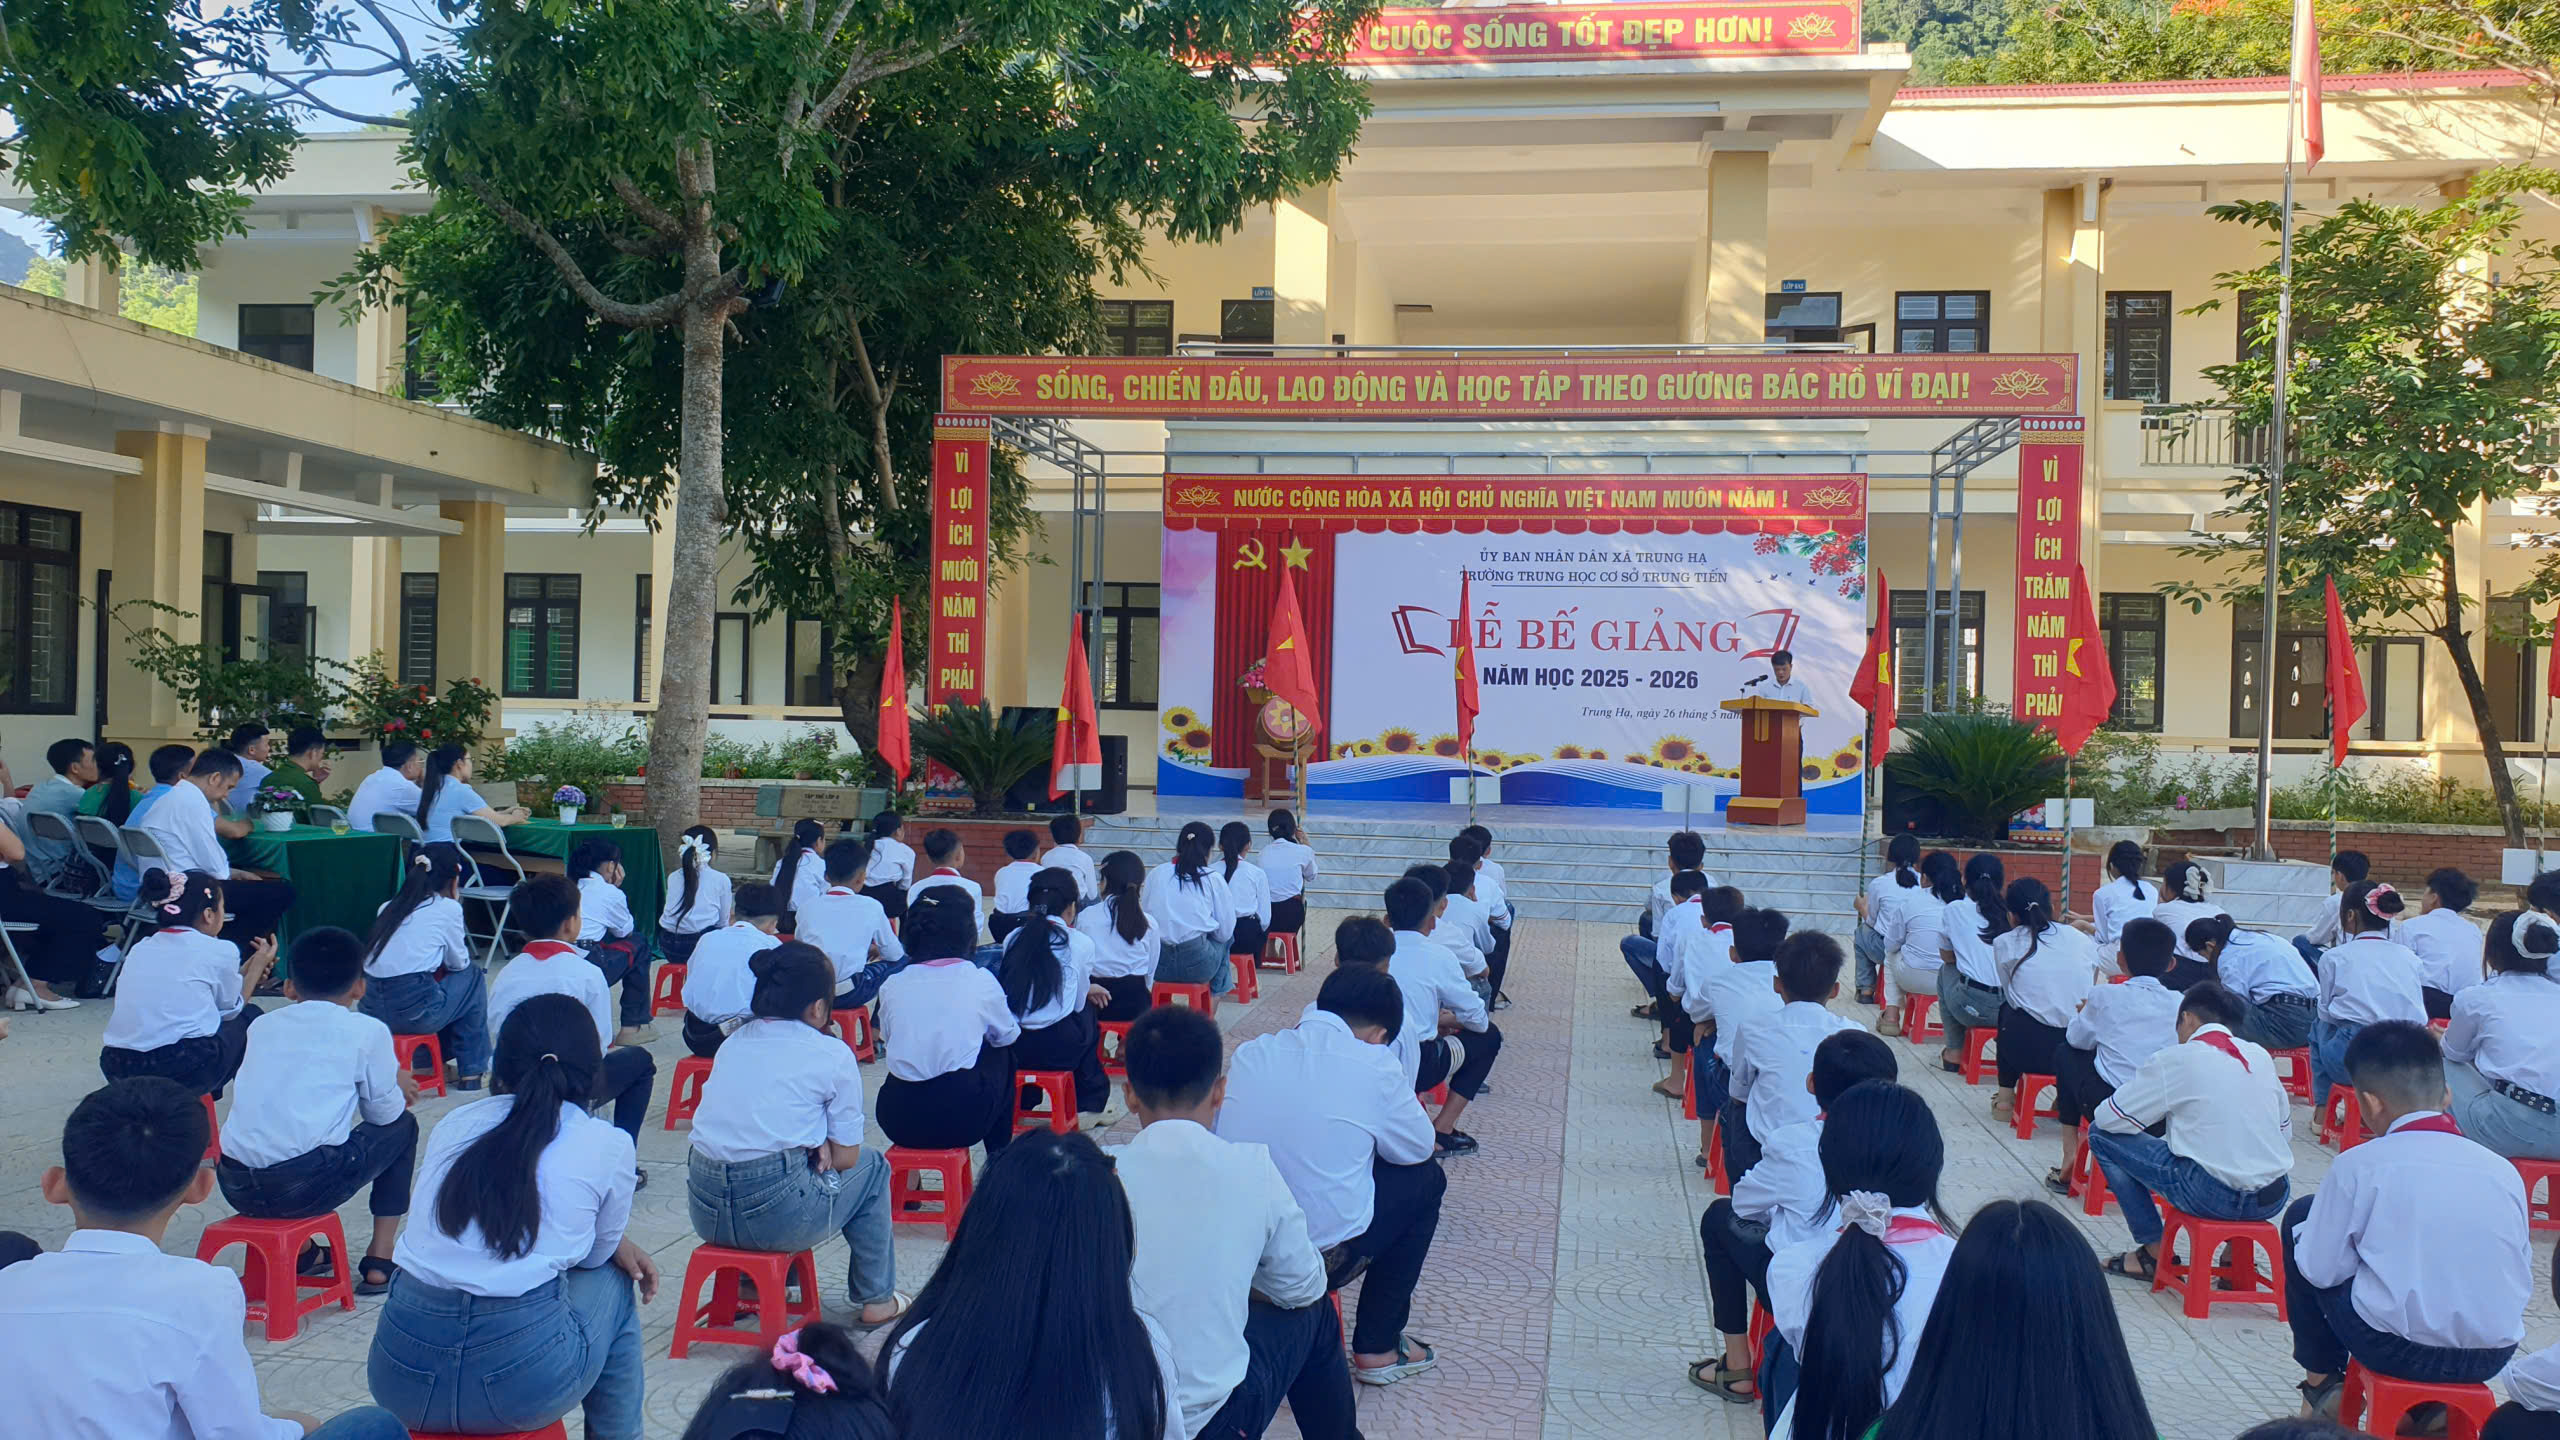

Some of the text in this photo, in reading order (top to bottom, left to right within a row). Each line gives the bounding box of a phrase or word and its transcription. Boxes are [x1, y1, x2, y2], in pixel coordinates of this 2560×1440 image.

[1370, 20, 1452, 56] CUỘC
[1463, 15, 1548, 48] SỐNG
[1558, 12, 1613, 46] TỐT
[1622, 19, 1684, 49] ĐẸP
[1694, 15, 1772, 43] HƠN!
[1036, 364, 1970, 408] SỐNG, CHIẾN ĐẤU, LAO ĐỘNG VÀ HỌC TẬP THEO GƯƠNG BÁC HỒ VĨ ĐẠI!
[955, 448, 969, 473] VÌ
[2043, 455, 2059, 482] VÌ
[951, 486, 973, 514] LỢI
[1234, 486, 1284, 507] NƯỚC
[1290, 486, 1339, 511] CỘNG
[1346, 486, 1383, 507] HÒA
[1389, 487, 1413, 507] XÃ
[1420, 487, 1450, 511] HỘI
[1457, 484, 1494, 508] CHỦ
[1500, 487, 1559, 508] NGHĨA
[1565, 487, 1604, 512] VIỆT
[1611, 490, 1657, 508] NAM
[1663, 487, 1722, 508] MUÔN
[1728, 486, 1775, 508] NĂM
[2036, 497, 2062, 526] LỢI
[949, 520, 973, 546] ÍCH
[2034, 533, 2062, 560] ÍCH
[942, 556, 978, 582] MƯỜI
[1480, 548, 1707, 565] ỦY BAN NHÂN DÂN XÃ TRUNG HẠ
[1518, 571, 1565, 582] TRUNG
[1569, 572, 1597, 584] HỌC
[1600, 571, 1618, 583] CƠ
[1621, 567, 1639, 583] SỞ
[1643, 572, 1690, 583] TRUNG
[1695, 567, 1728, 583] TIẾN
[2024, 571, 2070, 599] TRĂM
[943, 593, 976, 618] NĂM
[1516, 606, 1578, 650] BẾ
[1591, 607, 1742, 652] GIẢNG
[2027, 611, 2065, 638] NĂM
[948, 629, 970, 653] THÌ
[941, 662, 974, 690] PHẢI
[1483, 663, 1528, 686] NĂM
[1535, 668, 1574, 690] HỌC
[1581, 670, 1629, 687] 2025
[1649, 671, 1698, 689] 2026
[2032, 650, 2058, 677] THÌ
[1582, 706, 1612, 718] Trung
[1615, 707, 1633, 719] Hạ,
[1637, 708, 1661, 720] ngày
[1663, 708, 1675, 718] 26
[1678, 708, 1708, 721] tháng
[1711, 710, 1717, 719] 5
[2025, 686, 2063, 716] PHẢI
